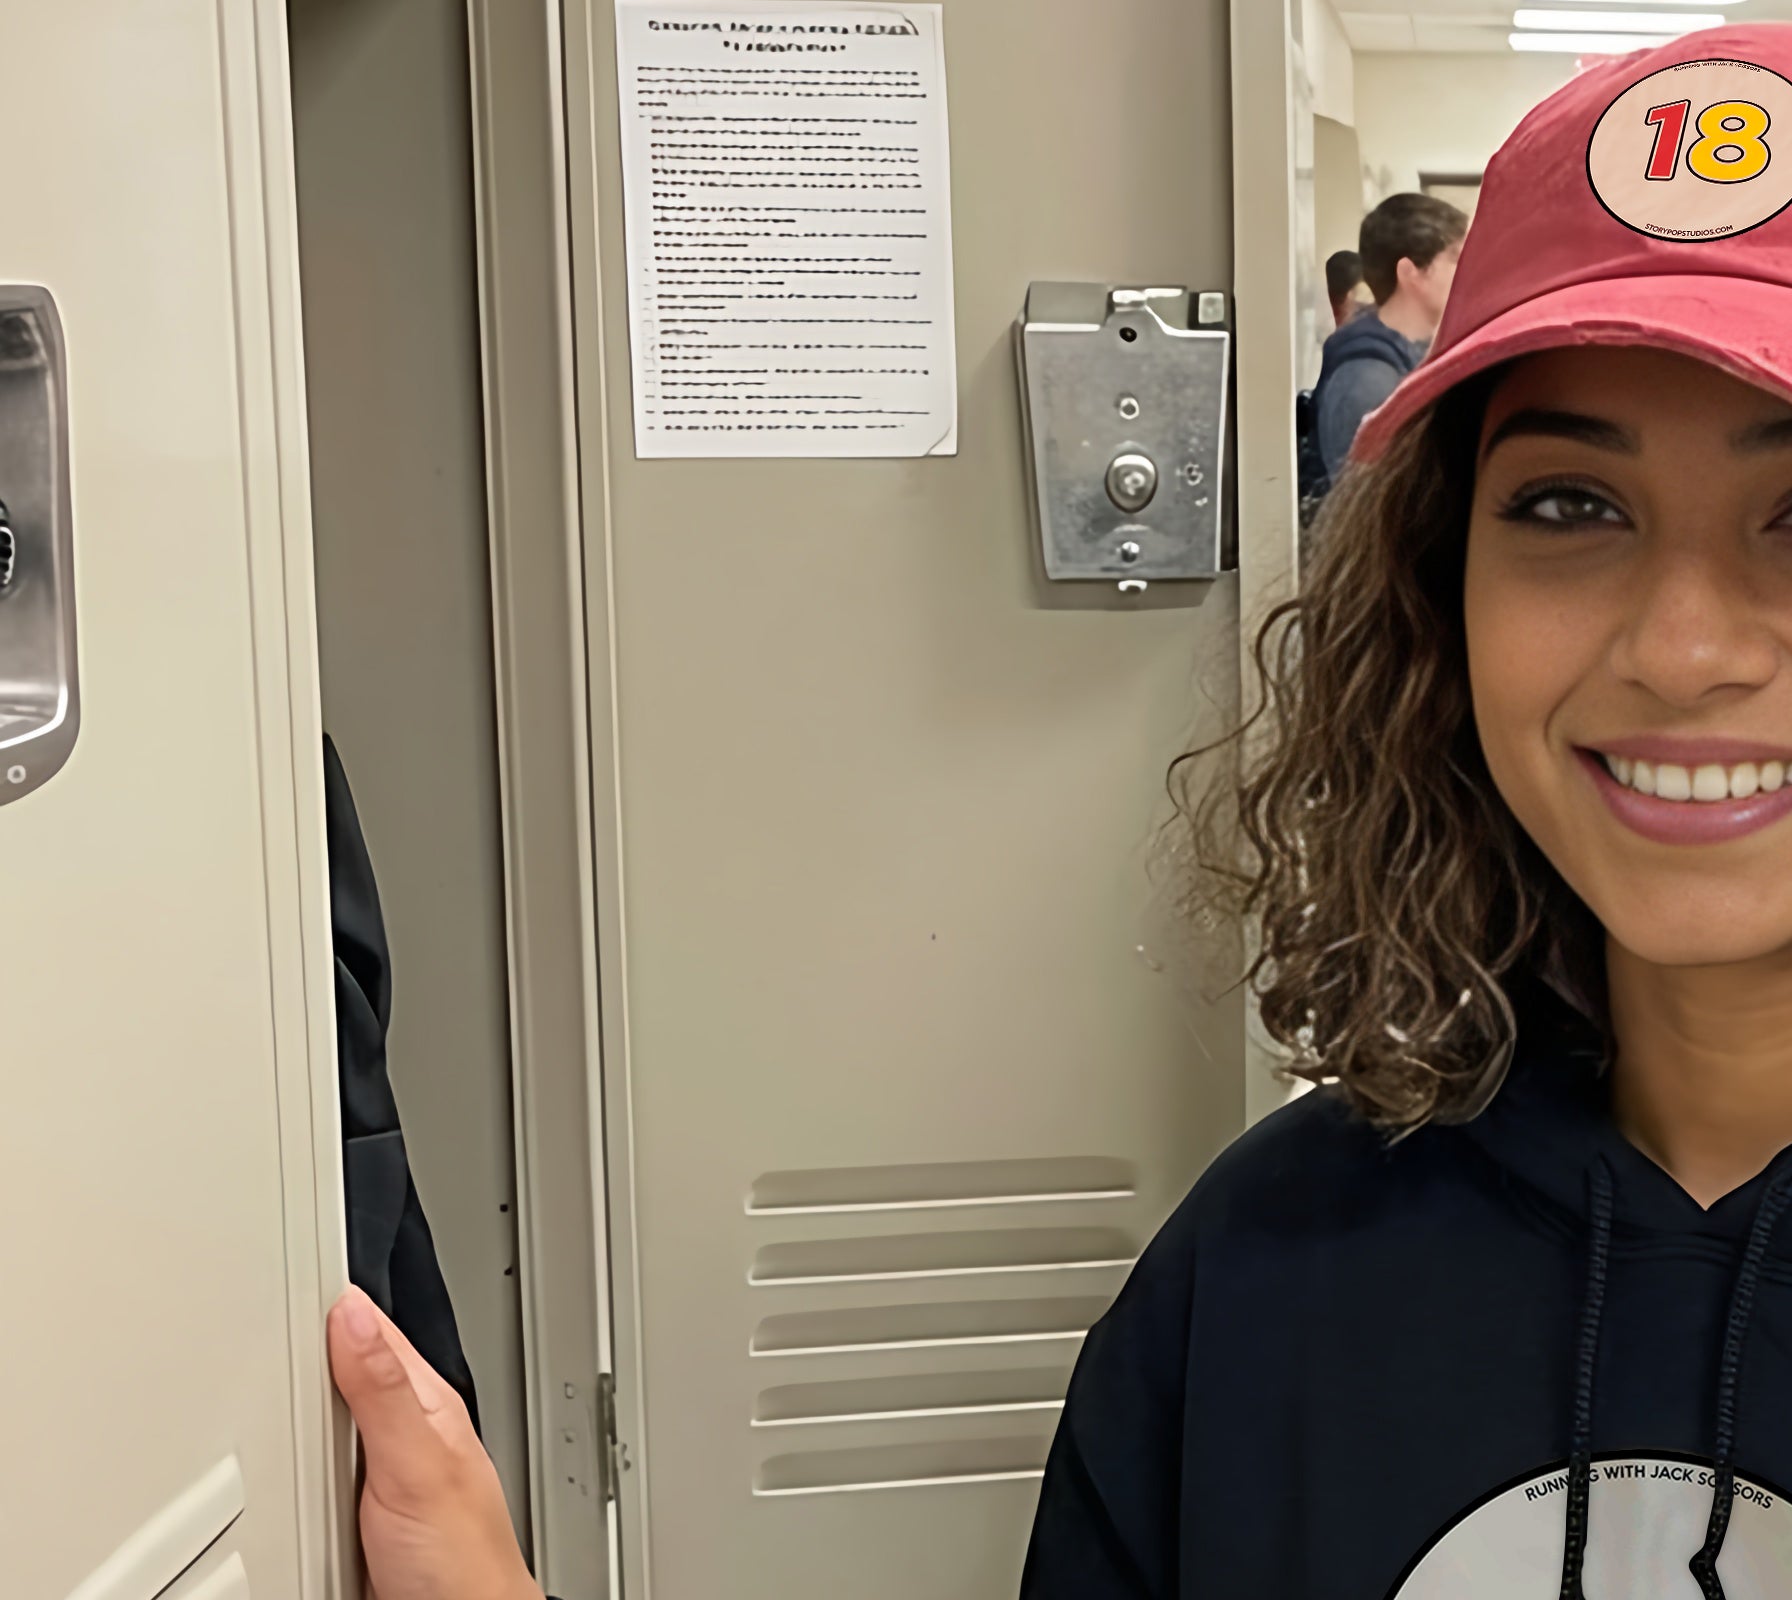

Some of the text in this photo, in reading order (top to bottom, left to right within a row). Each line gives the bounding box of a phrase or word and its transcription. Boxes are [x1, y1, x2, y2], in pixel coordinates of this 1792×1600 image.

[1644, 99, 1772, 184] 18
[1644, 223, 1734, 237] STORYPOPSTUDIOS.COM
[1524, 1465, 1774, 1509] RUNNG WITH JACK SCSORS
